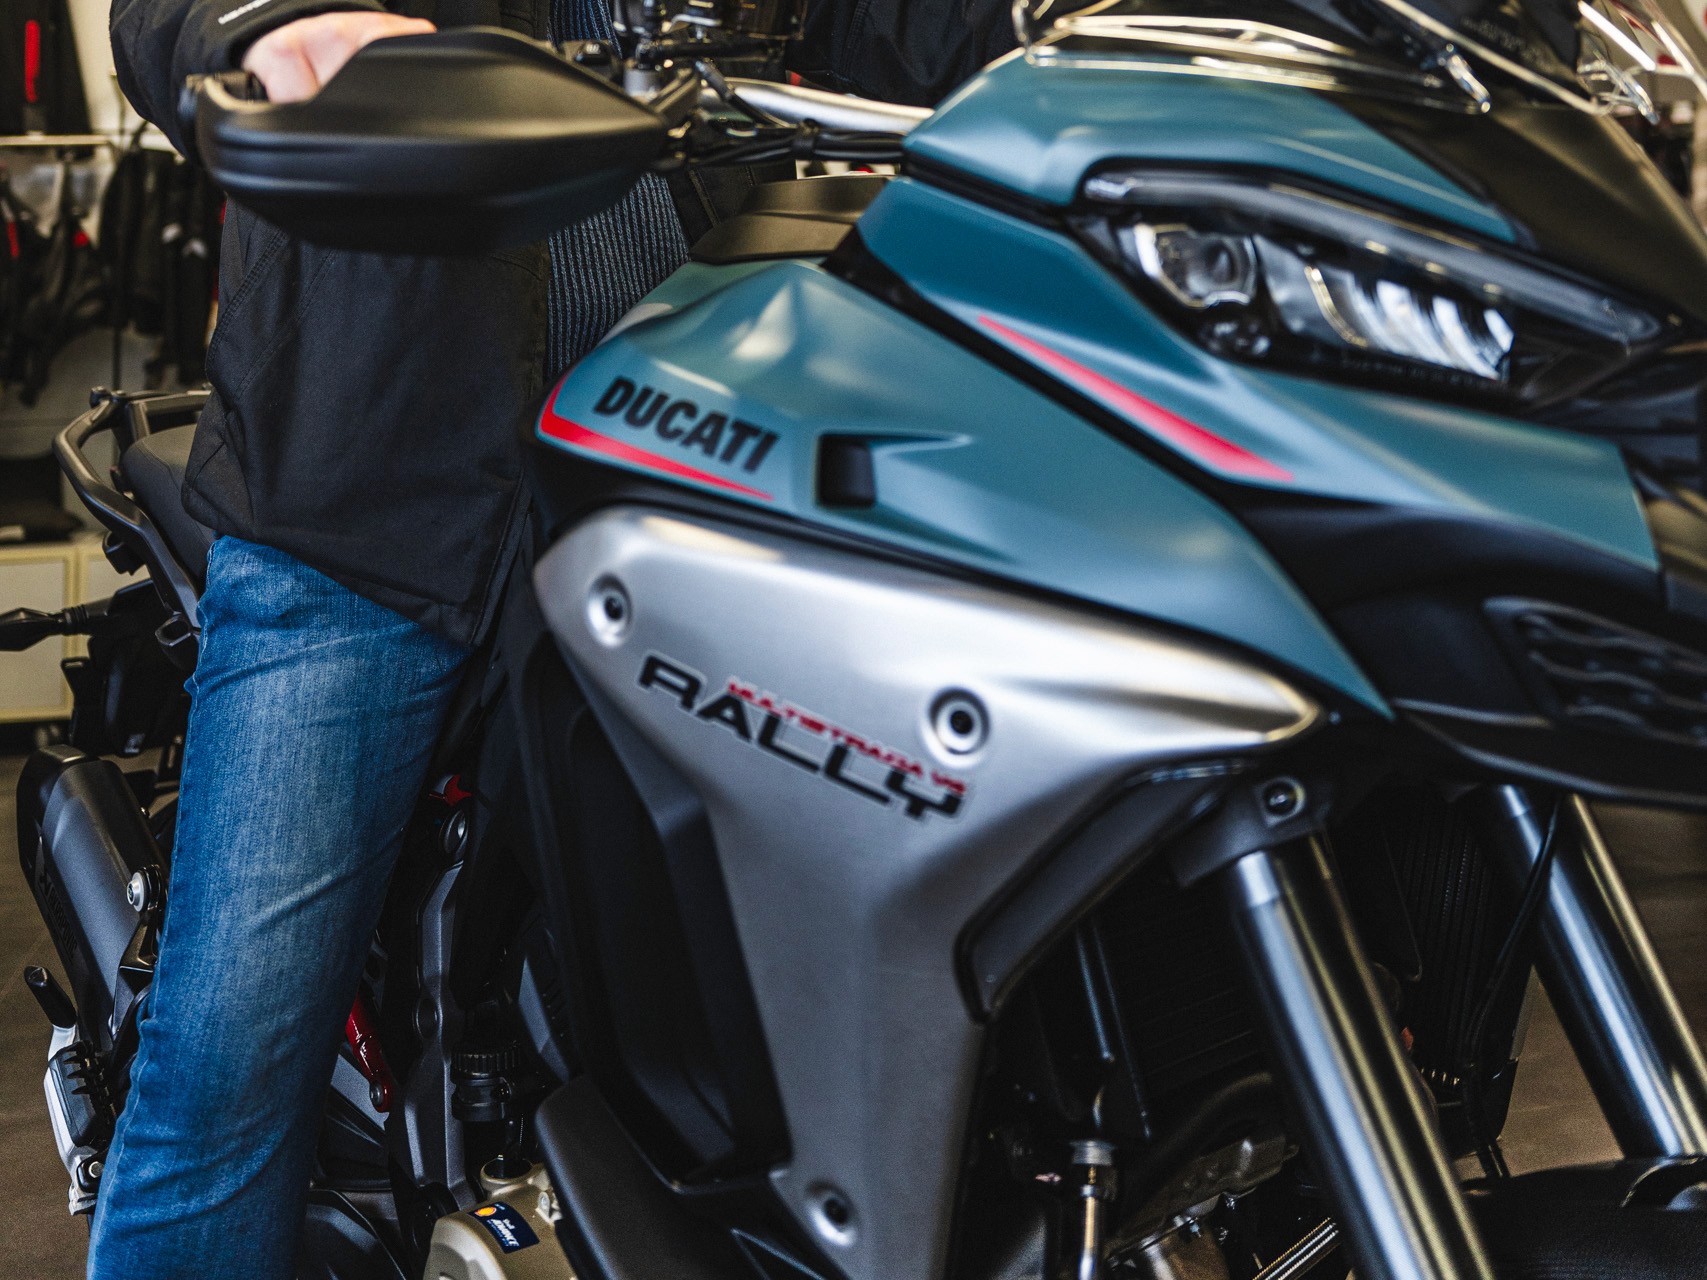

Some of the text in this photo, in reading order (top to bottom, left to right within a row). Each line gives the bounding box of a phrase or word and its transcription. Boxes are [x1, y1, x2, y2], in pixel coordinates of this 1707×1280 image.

[593, 375, 781, 475] DUCATI
[638, 654, 964, 820] RALLY
[727, 680, 924, 779] MULTISTRADA
